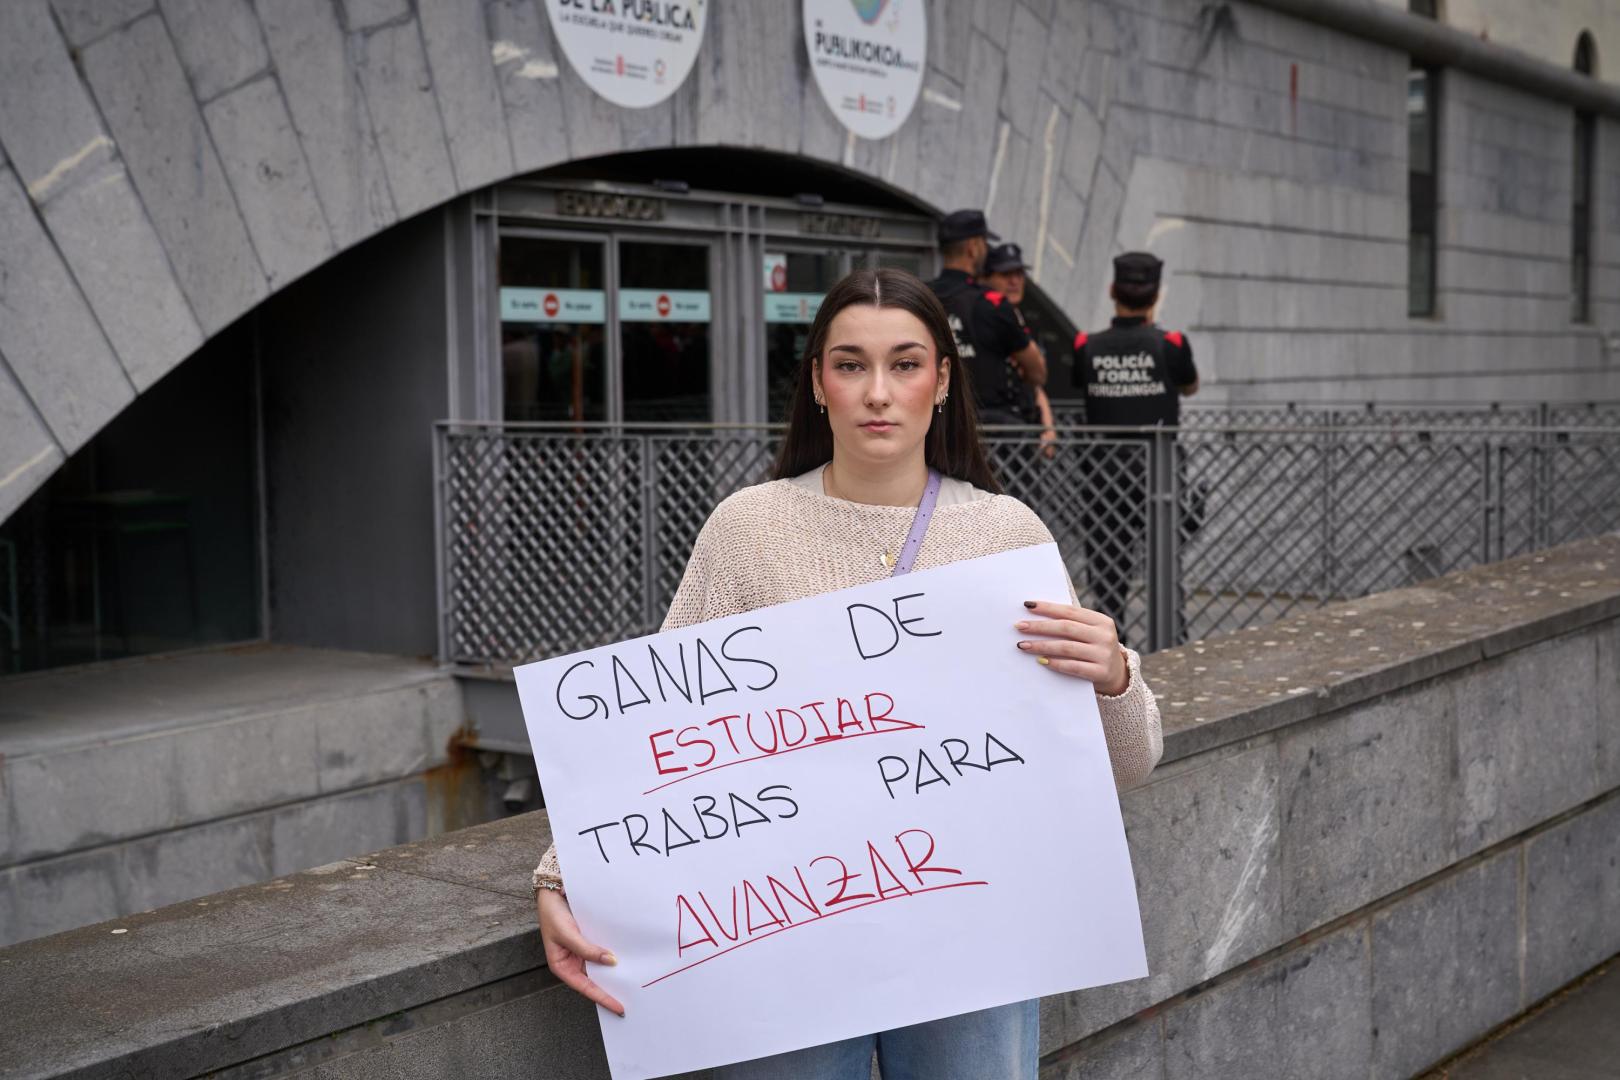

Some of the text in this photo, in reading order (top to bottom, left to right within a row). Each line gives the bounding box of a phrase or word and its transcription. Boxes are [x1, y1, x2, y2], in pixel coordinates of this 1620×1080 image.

[1092, 351, 1155, 370] POLICÍA
[1097, 369, 1152, 384] FORAL
[556, 593, 942, 720] GANAS DE
[649, 692, 922, 776] ESTUDIAR
[579, 732, 1025, 863] TRABAS PARA
[676, 829, 962, 958] AVANZAR
